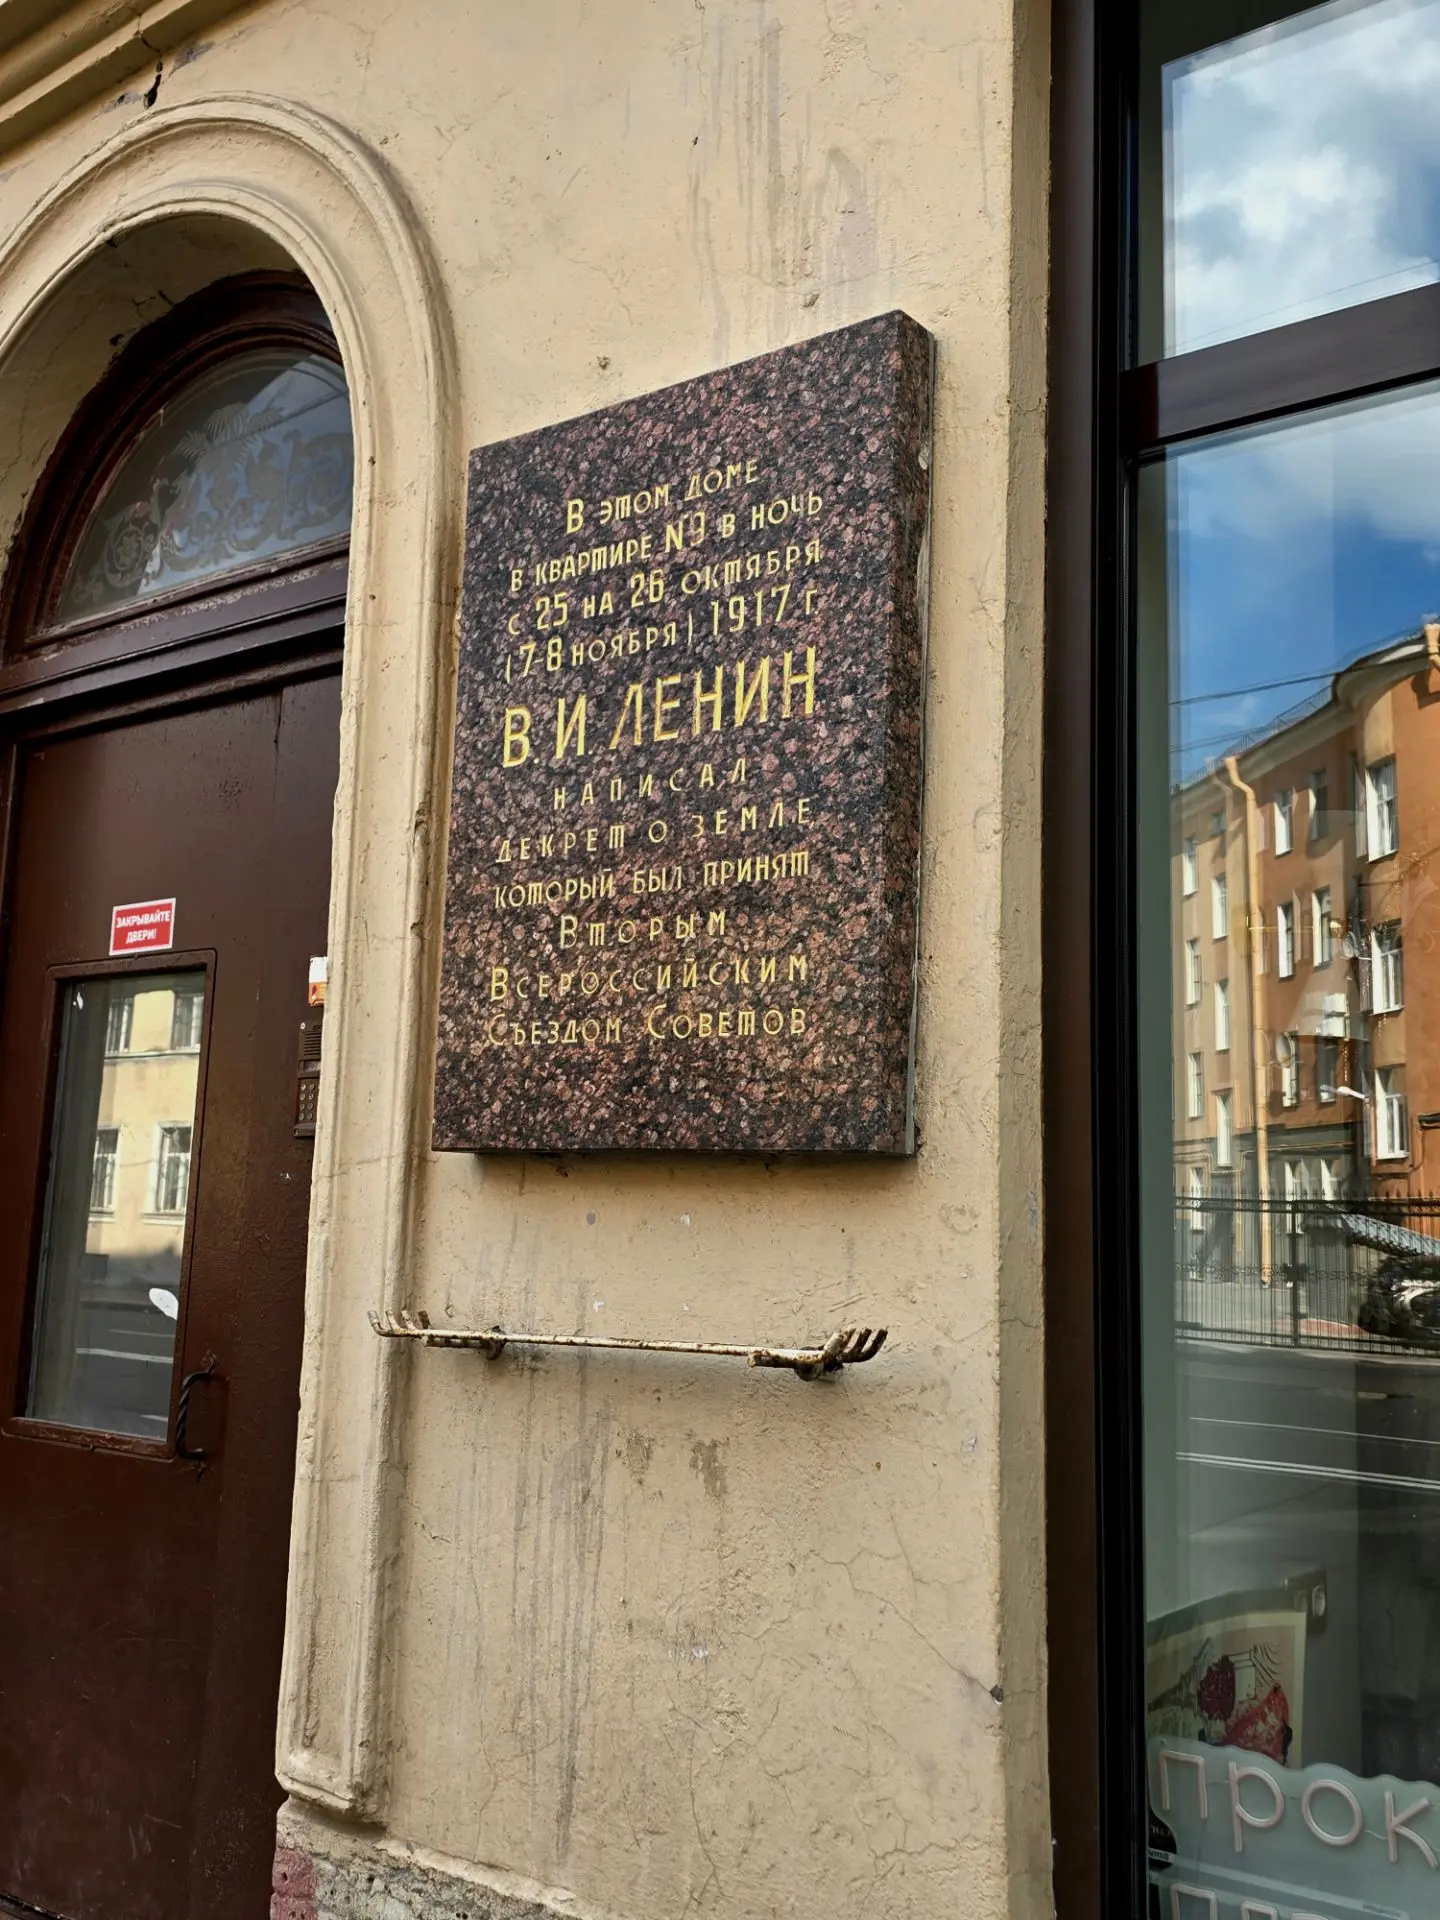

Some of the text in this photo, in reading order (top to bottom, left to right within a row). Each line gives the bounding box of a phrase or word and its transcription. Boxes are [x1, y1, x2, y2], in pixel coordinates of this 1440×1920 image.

[567, 459, 759, 534] В ЭТОМ ДОМЕ
[511, 570, 523, 592] В
[535, 534, 652, 586] КВАРТИРЕ
[722, 514, 736, 538] В
[751, 491, 823, 531] НОЧЬ
[535, 591, 568, 630] 25
[583, 591, 614, 619] НА
[631, 569, 664, 608] 26
[681, 539, 821, 594] ОКТЯБРЯ
[711, 583, 791, 636] 1917
[503, 645, 817, 768] В. И. ЛЕНИН
[554, 757, 748, 810] НАПИСАЛ
[496, 826, 626, 863] ДЕКРЕТ
[648, 819, 668, 843] О
[496, 850, 810, 908] КОТОРЫЙ БЫЛ ПРИНЯТ
[115, 909, 171, 928] ЗАКРЫВАЙТЕ
[125, 928, 157, 944] ДВЕРИ!
[560, 911, 726, 949] ВТОРЫМ
[490, 955, 807, 1001] ВСЕРОССИЙСКИМ
[488, 1004, 806, 1046] СЪЕЗДОМ СОВЕТОВ
